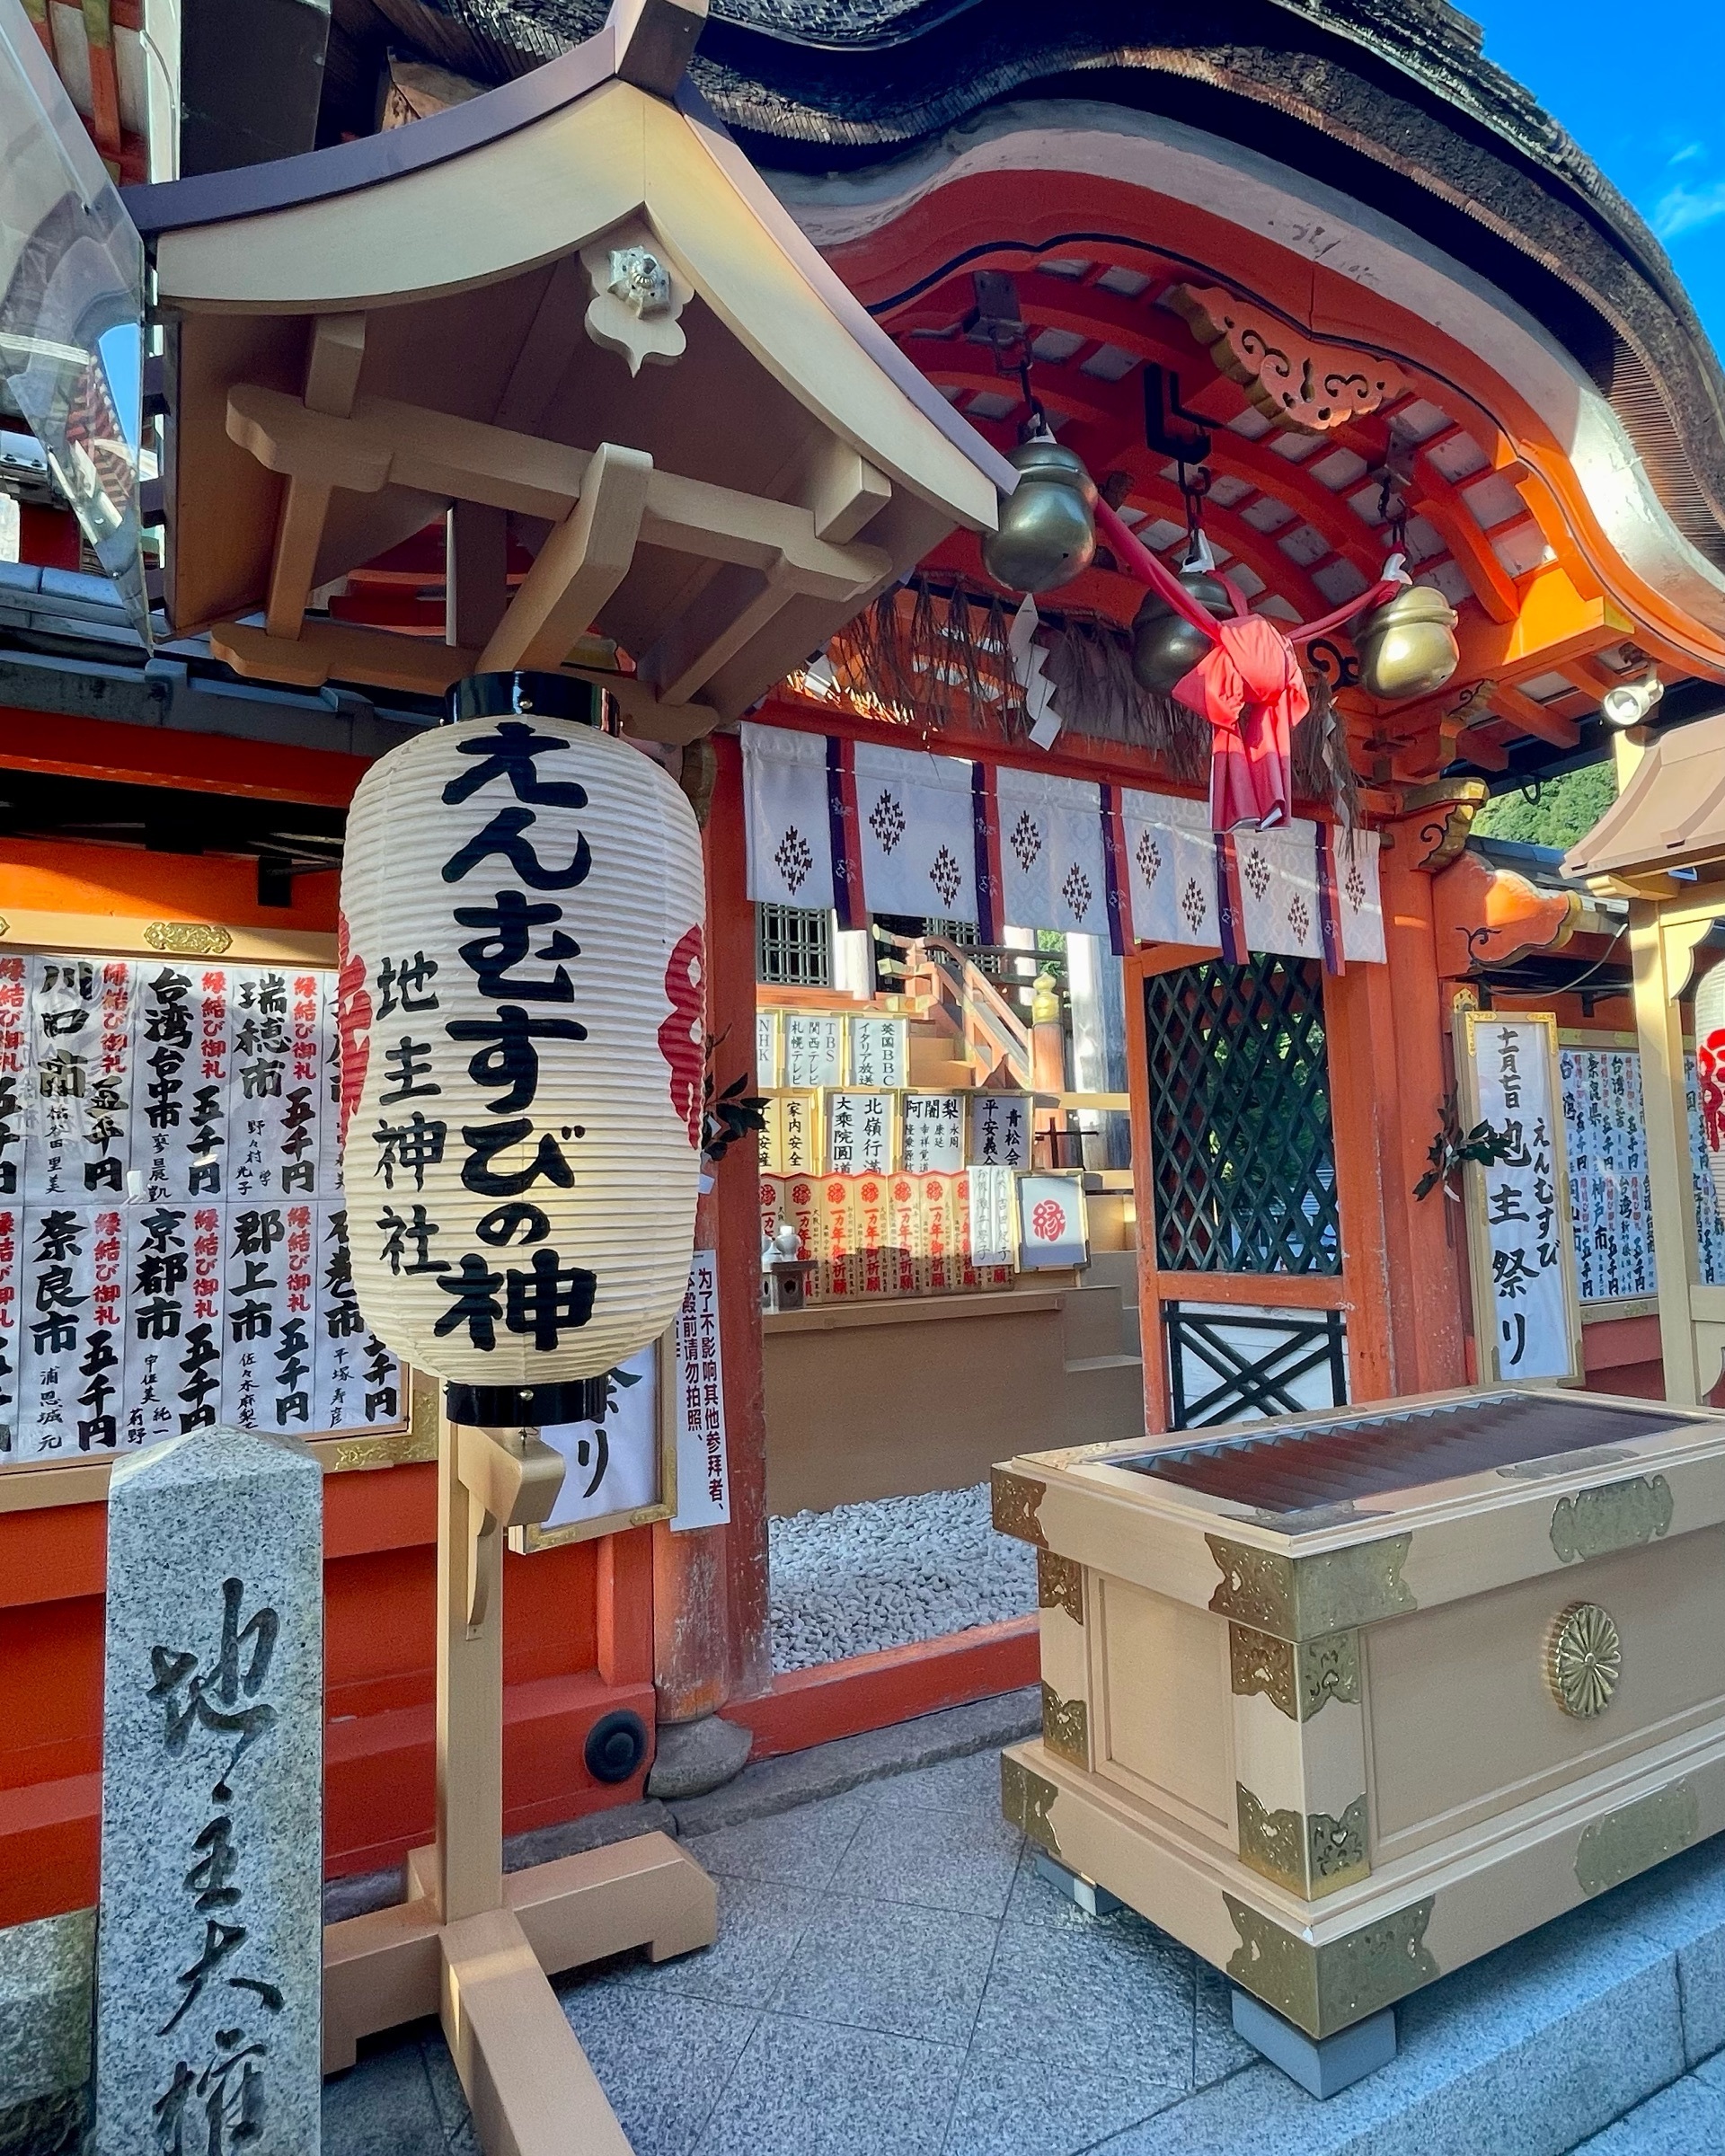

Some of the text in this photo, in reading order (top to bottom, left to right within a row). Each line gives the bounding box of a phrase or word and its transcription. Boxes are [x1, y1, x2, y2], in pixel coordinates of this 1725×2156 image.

[101, 963, 128, 1074] 縁結び御礼
[144, 968, 193, 1129] 台湾台中市
[200, 971, 226, 1079] 縁結び御礼
[234, 973, 291, 1100] 瑞穂市
[291, 976, 317, 1080] 縁結び御礼
[435, 722, 597, 1351] えんむすびの神
[792, 1021, 803, 1085] 札幌テレビ
[826, 1022, 836, 1062] TBS
[858, 1022, 874, 1086] イタリア放送
[881, 1023, 896, 1086] 英国BBC
[1497, 1027, 1521, 1109] 十一月七日
[187, 1085, 225, 1196] 五千円
[280, 1087, 314, 1194] 五千円
[372, 950, 451, 1277] 地主神社
[787, 1101, 804, 1167] 家内安全
[1004, 1109, 1022, 1166] 青松会
[1533, 1118, 1561, 1268] えんむすび
[1592, 1177, 1608, 1250] 神戸市
[29, 1210, 90, 1356] 奈良市
[93, 1212, 121, 1326] 縁結び御礼
[132, 1207, 188, 1340] 京都市
[192, 1208, 219, 1320] 縁結び御礼
[228, 1209, 286, 1343] 郡上市
[287, 1206, 312, 1312] 縁結び御礼
[77, 1330, 119, 1452] 五千円
[178, 1323, 220, 1436] 五千円
[274, 1318, 310, 1426] 五千円
